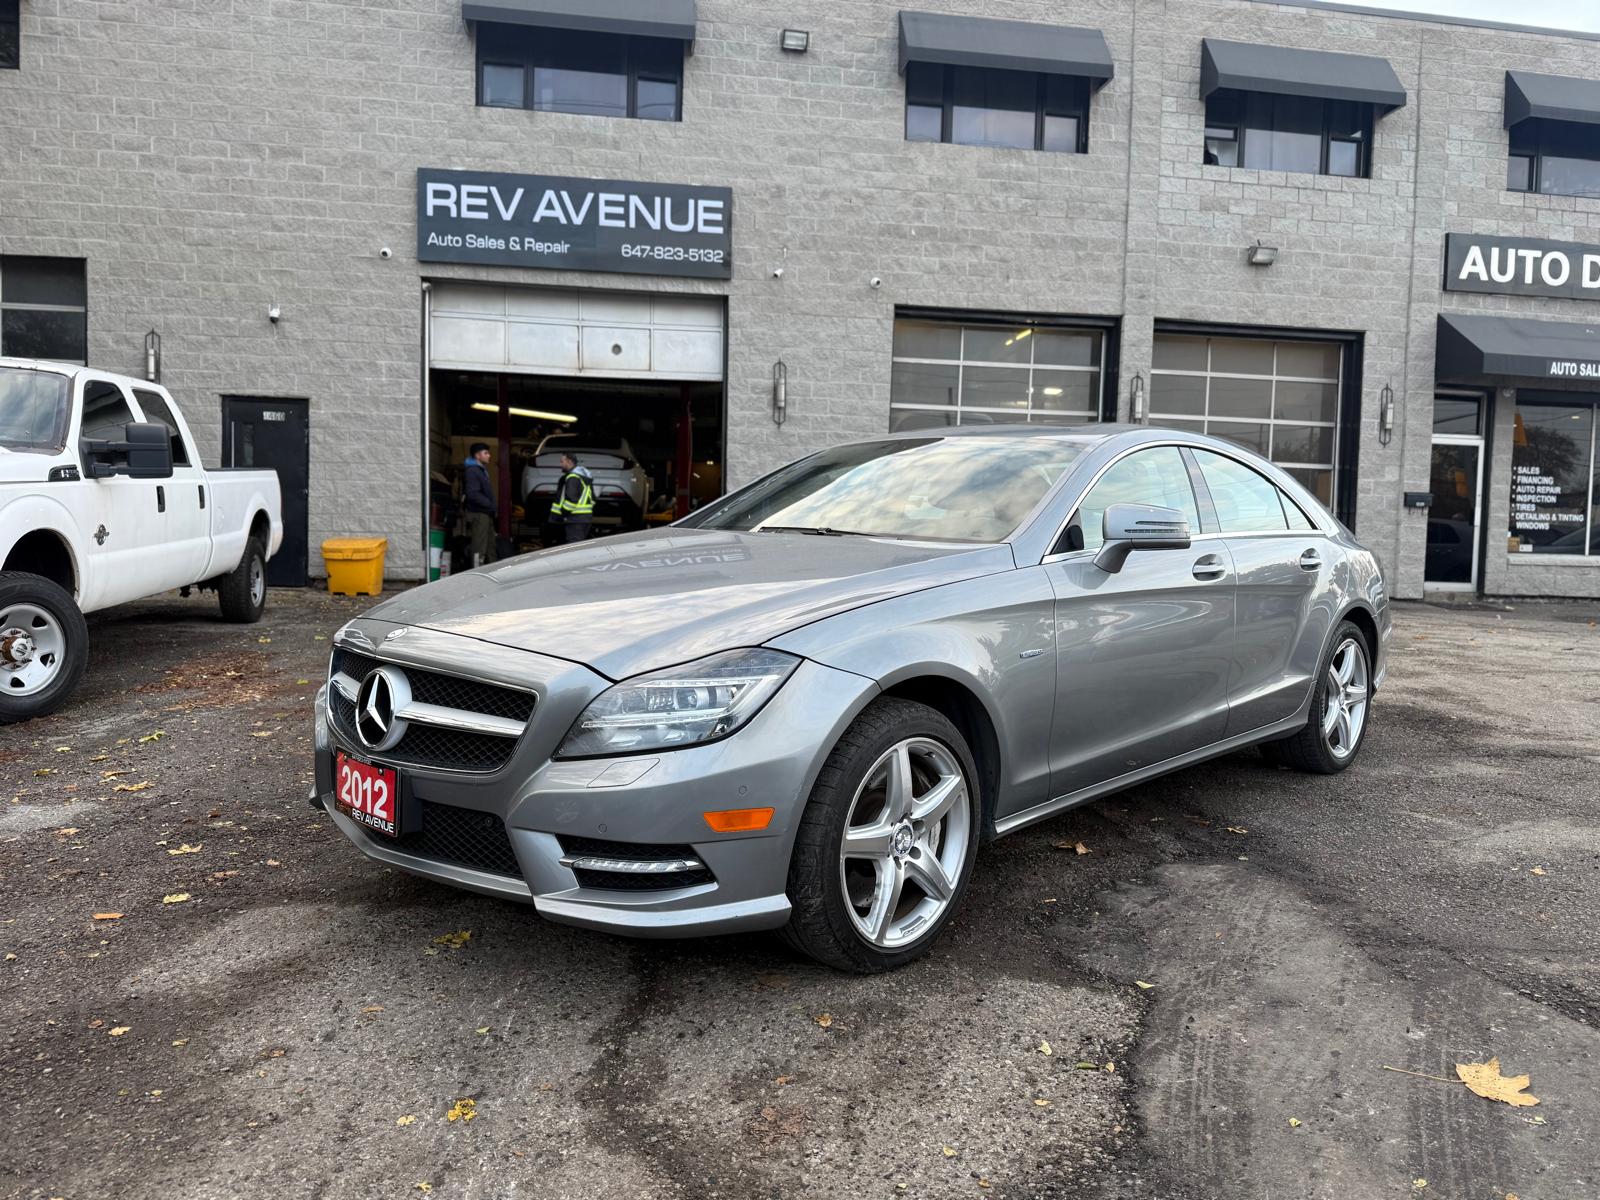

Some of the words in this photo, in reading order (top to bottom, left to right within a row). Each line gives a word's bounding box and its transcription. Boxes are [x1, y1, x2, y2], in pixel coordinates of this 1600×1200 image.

[426, 182, 524, 221] REV
[532, 189, 724, 234] AVENUE
[427, 232, 462, 247] Auto
[466, 235, 505, 250] Sales
[509, 237, 521, 250] &
[524, 239, 570, 254] Repair
[621, 244, 724, 263] 647-823-5132
[1458, 245, 1570, 286] AUTO
[1550, 361, 1577, 375] AUTO
[1579, 363, 1600, 376] SAL
[1517, 466, 1540, 475] SALES
[1516, 476, 1554, 485] FINANCING
[1537, 486, 1561, 494] REPAIR
[1515, 495, 1557, 503] INSPECTION
[1516, 503, 1536, 511] TIRES
[1515, 512, 1550, 521] DETAILING
[1551, 514, 1557, 522] &
[1558, 513, 1584, 522] TINTING
[1515, 522, 1549, 530] WINDOWS
[342, 765, 387, 818] 2012
[351, 808, 365, 820] REV
[365, 814, 394, 833] AVENUE
